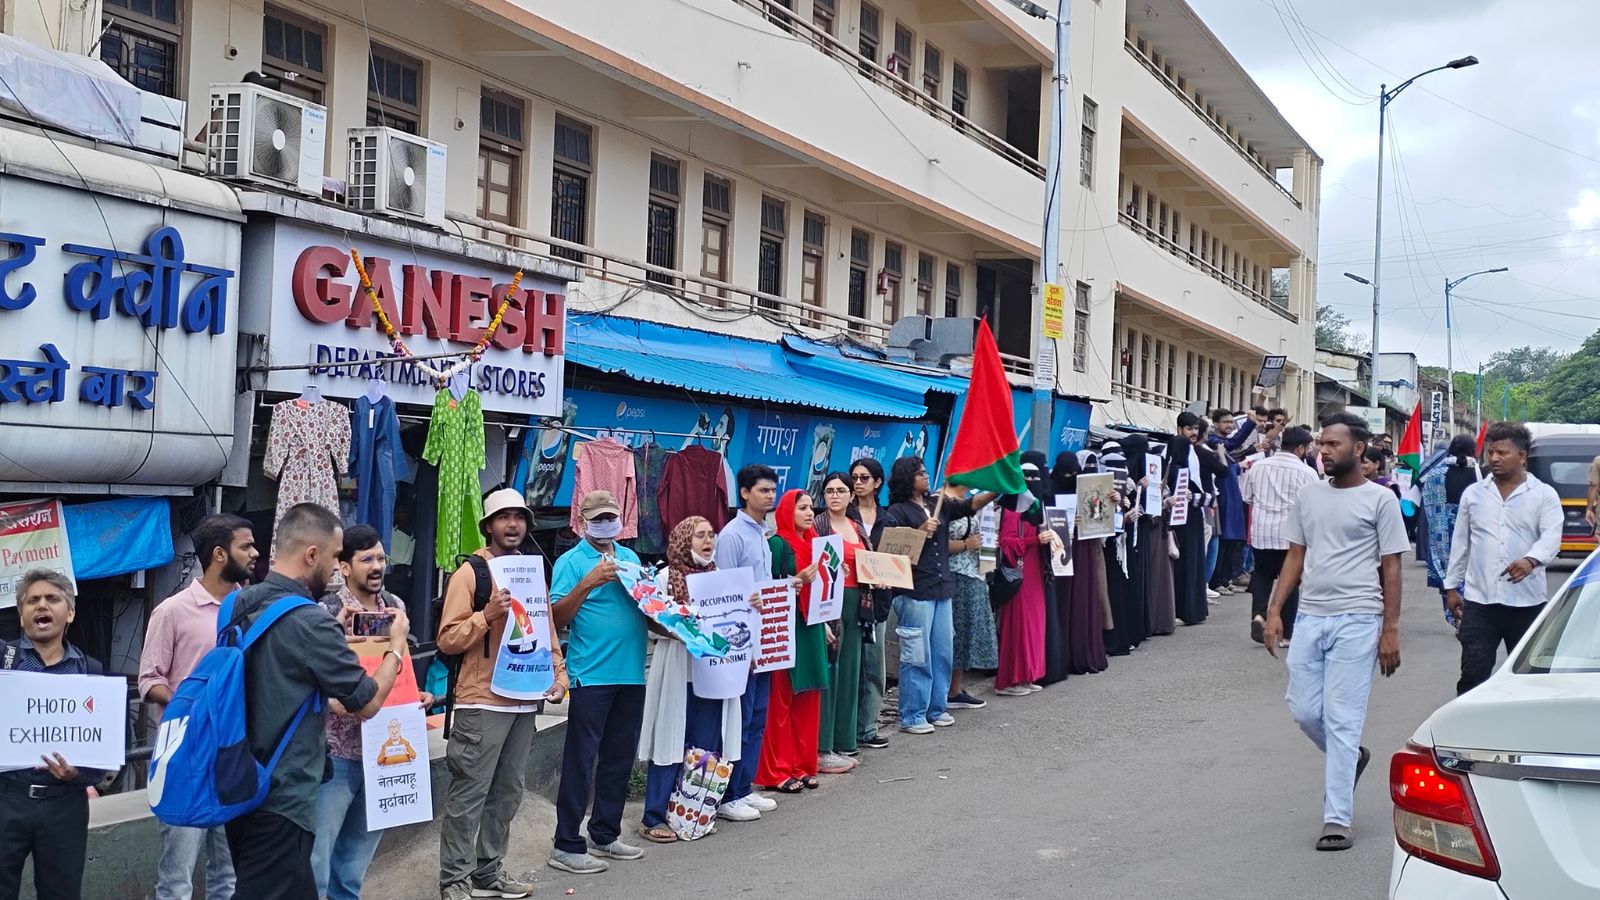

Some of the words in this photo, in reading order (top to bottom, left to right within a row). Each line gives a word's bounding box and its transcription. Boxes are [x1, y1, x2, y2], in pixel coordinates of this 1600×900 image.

[62, 226, 235, 335] क्वीन
[291, 245, 565, 356] GANESH
[311, 344, 476, 389] DEPARTMENTL
[482, 364, 546, 398] STORES
[79, 365, 158, 410] बार
[626, 408, 645, 420] pepsi
[757, 415, 798, 456] गणेश
[538, 462, 555, 473] pepsi
[1, 542, 60, 569] Payment
[700, 594, 744, 608] OCCUPATION
[4, 645, 17, 670] safari
[507, 663, 526, 673] FREE
[526, 664, 535, 673] THE
[710, 657, 718, 667] IS
[27, 698, 77, 714] PHOTO
[9, 726, 102, 744] EXHIBITION
